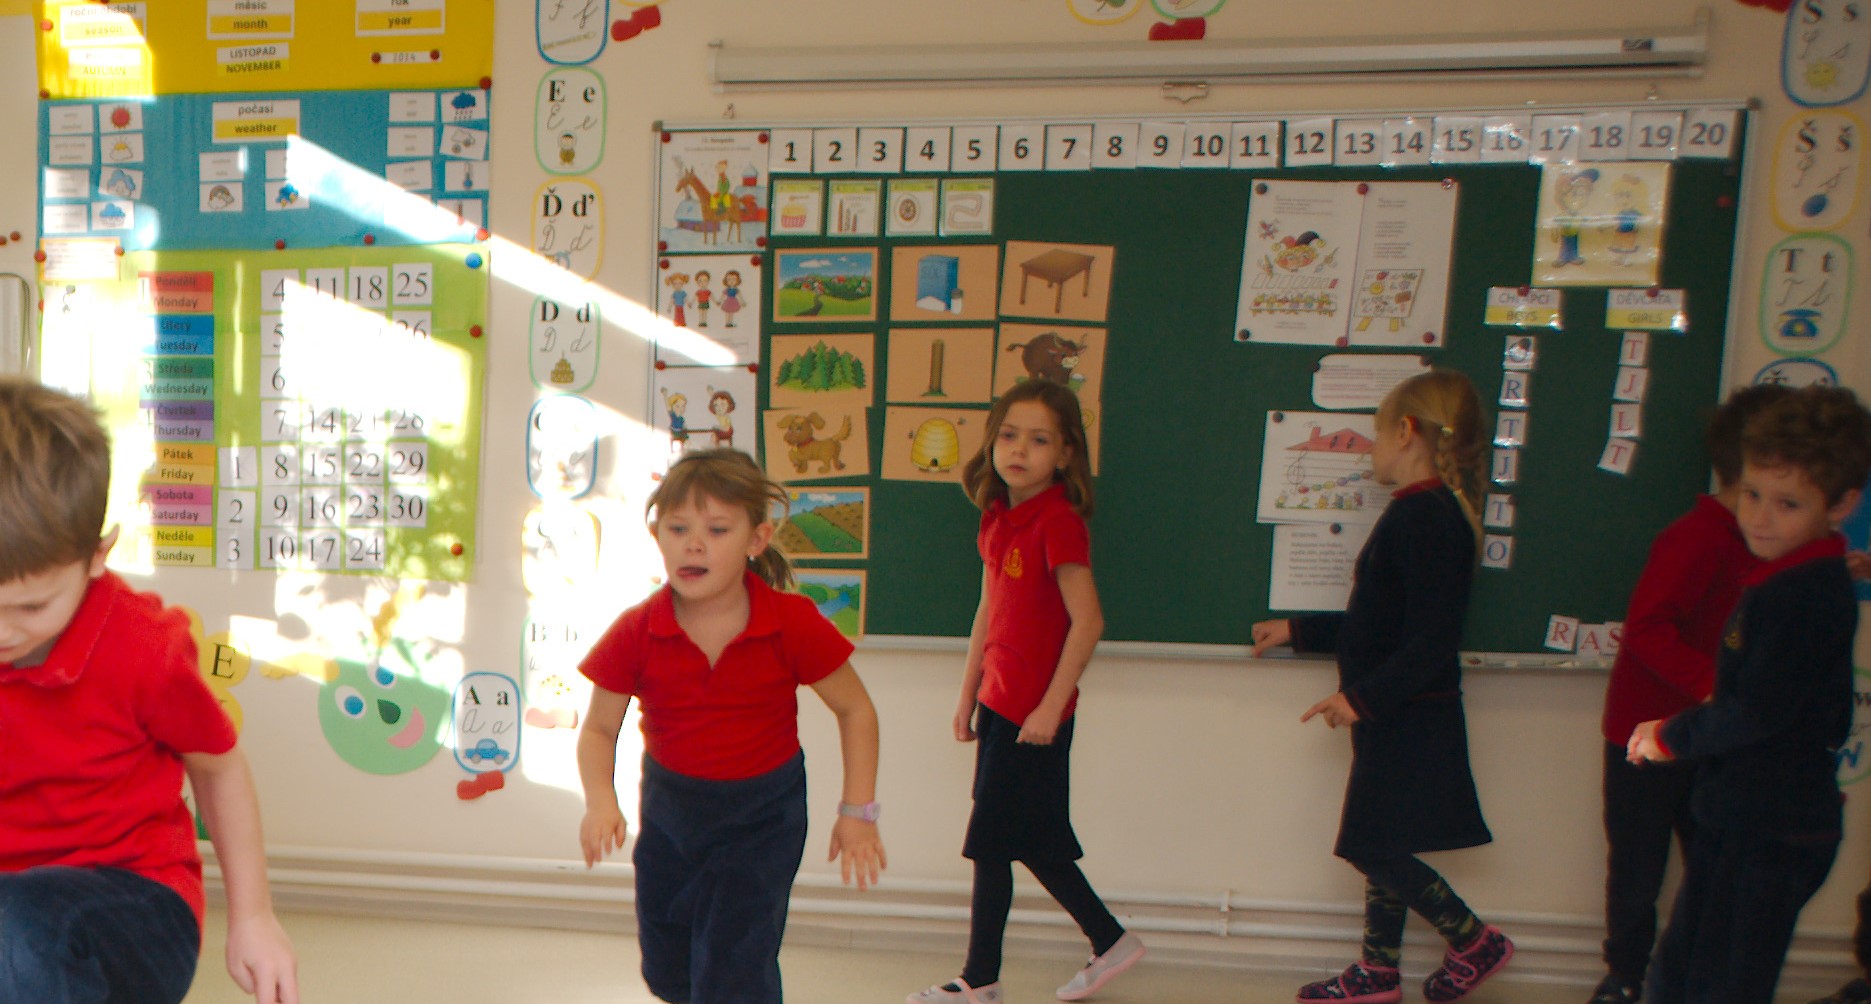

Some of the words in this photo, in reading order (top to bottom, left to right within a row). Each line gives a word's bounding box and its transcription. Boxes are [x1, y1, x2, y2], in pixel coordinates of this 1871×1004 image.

[388, 16, 412, 29] year
[1802, 0, 1823, 25] S
[1842, 2, 1858, 23] s
[233, 18, 268, 30] month
[229, 46, 277, 59] LISTOPAD
[226, 60, 282, 74] NOVEMBER
[548, 79, 566, 103] E
[582, 86, 596, 103] e
[238, 104, 274, 116] počasí
[234, 123, 277, 134] weather
[1795, 119, 1818, 153] Š
[1836, 125, 1854, 152] š
[784, 141, 797, 162] 1
[828, 140, 843, 162] 2
[872, 140, 888, 162] 3
[919, 139, 936, 161] 4
[966, 139, 982, 161] 5
[1014, 137, 1030, 160] 6
[1062, 138, 1077, 160] 7
[1106, 135, 1124, 158] 8
[1152, 134, 1169, 157] 9
[1191, 134, 1225, 157] 10
[1239, 134, 1271, 157] 11
[1293, 131, 1325, 154] 12
[1343, 132, 1376, 155] 13
[1391, 131, 1424, 154] 14
[1441, 129, 1474, 152] 15
[1492, 128, 1523, 152] 16
[1539, 127, 1574, 151] 17
[1590, 125, 1624, 149] 18
[1638, 125, 1673, 149] 19
[1689, 122, 1726, 146] 20
[542, 186, 563, 218] Ď
[571, 193, 595, 218] ď
[1779, 247, 1804, 273] T
[1821, 251, 1836, 273] t
[272, 277, 286, 302] 4
[354, 275, 383, 302] 18
[396, 271, 429, 298] 25
[155, 297, 199, 309] Monday
[1498, 292, 1550, 305] CHPCI
[541, 300, 560, 322] D
[576, 302, 591, 323] d
[158, 341, 198, 353] uesday
[1623, 339, 1643, 360] T
[271, 367, 286, 391] 6
[1624, 374, 1636, 394] J
[144, 383, 209, 396] Wednesday
[1505, 380, 1521, 399] R
[273, 409, 287, 435] 7
[310, 408, 337, 434] 14
[1503, 418, 1520, 438] T
[1617, 411, 1632, 432] L
[162, 448, 194, 460] Pátek
[1610, 444, 1628, 466] T
[160, 468, 195, 482] Friday
[234, 456, 242, 480] 1
[274, 453, 289, 479] 8
[310, 453, 336, 478] 15
[349, 452, 380, 478] 22
[392, 450, 424, 476] 29
[1498, 456, 1510, 476] J
[156, 489, 195, 500] Sobota
[152, 511, 199, 522] Saturday
[229, 498, 244, 524] 2
[273, 494, 288, 520] 9
[308, 495, 336, 520] 16
[348, 494, 380, 520] 23
[390, 494, 424, 520] 30
[1492, 501, 1508, 521] T
[156, 529, 195, 542] Neděle
[156, 551, 195, 563] Sunday
[228, 538, 241, 563] 3
[266, 535, 296, 561] 10
[309, 538, 336, 562] 17
[349, 537, 381, 562] 24
[1486, 540, 1507, 561] O
[210, 643, 236, 681] E
[463, 684, 481, 705] A
[496, 690, 510, 706] a
